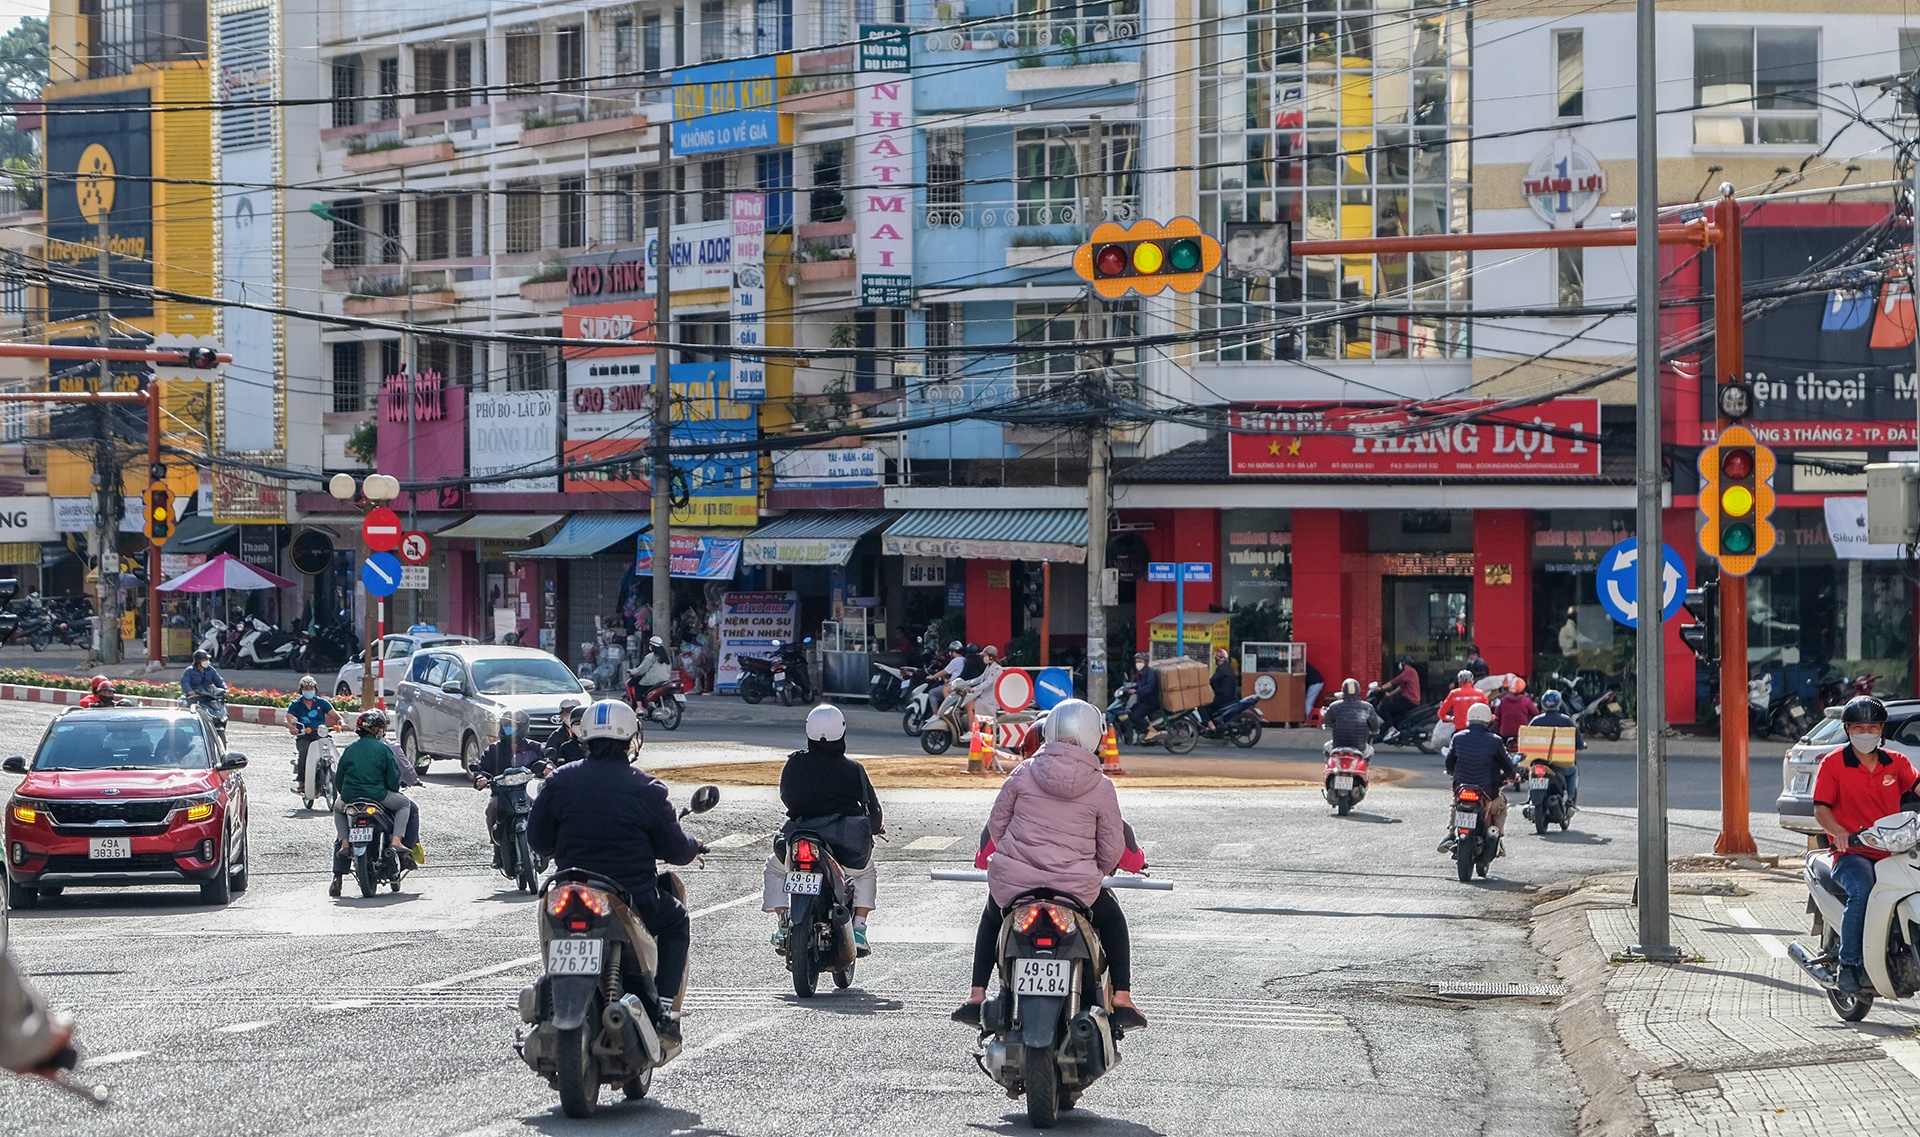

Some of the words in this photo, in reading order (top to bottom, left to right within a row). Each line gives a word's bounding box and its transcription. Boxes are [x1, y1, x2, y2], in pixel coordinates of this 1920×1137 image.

[864, 59, 880, 69] DU
[711, 69, 736, 114] GIÁ
[741, 74, 773, 110] KHO
[681, 128, 715, 148] KHÔNG
[718, 128, 730, 144] LO
[733, 120, 747, 140] VỀ
[750, 120, 768, 140] GIÁ
[736, 197, 762, 216] Phở
[735, 222, 762, 239] NGỌC
[50, 233, 145, 266] thegioiidong
[738, 240, 760, 259] HIỆP
[570, 264, 600, 295] CAO
[605, 258, 645, 292] SANG
[741, 291, 753, 306] TÁI
[580, 315, 633, 341] SUPOR
[1745, 372, 1788, 408] ện
[1796, 371, 1866, 408] thoại
[573, 387, 604, 412] CAO
[476, 398, 496, 418] PHỞ
[498, 399, 511, 418] BÒ
[477, 421, 519, 453] ĐÔNG
[524, 422, 551, 456] LỢI
[1492, 416, 1556, 461] LỢI
[1569, 422, 1588, 453] 1
[1783, 428, 1790, 441] 3
[1794, 425, 1841, 441] THÁNG
[1846, 428, 1853, 441] 2
[1887, 425, 1908, 441] ĐÀ
[1805, 464, 1858, 476] HUA
[1833, 534, 1854, 543] Siêu
[243, 543, 269, 552] Thanh
[763, 541, 777, 560] PHỞ
[916, 540, 960, 554] Café
[243, 554, 267, 564] Thiên
[937, 568, 945, 581] TA
[725, 616, 748, 627] NỆM
[752, 617, 773, 626] CAO
[776, 617, 791, 626] SU
[723, 628, 754, 637] THIÊN
[757, 628, 791, 637] NHIÊN
[101, 838, 119, 848] 49A
[94, 848, 126, 858] 383.61
[790, 874, 816, 883] 49-G1
[556, 941, 593, 955] 49-B1
[550, 957, 599, 972] 276.75
[1024, 962, 1061, 977] 49-G1
[1018, 978, 1066, 993] 214.84
